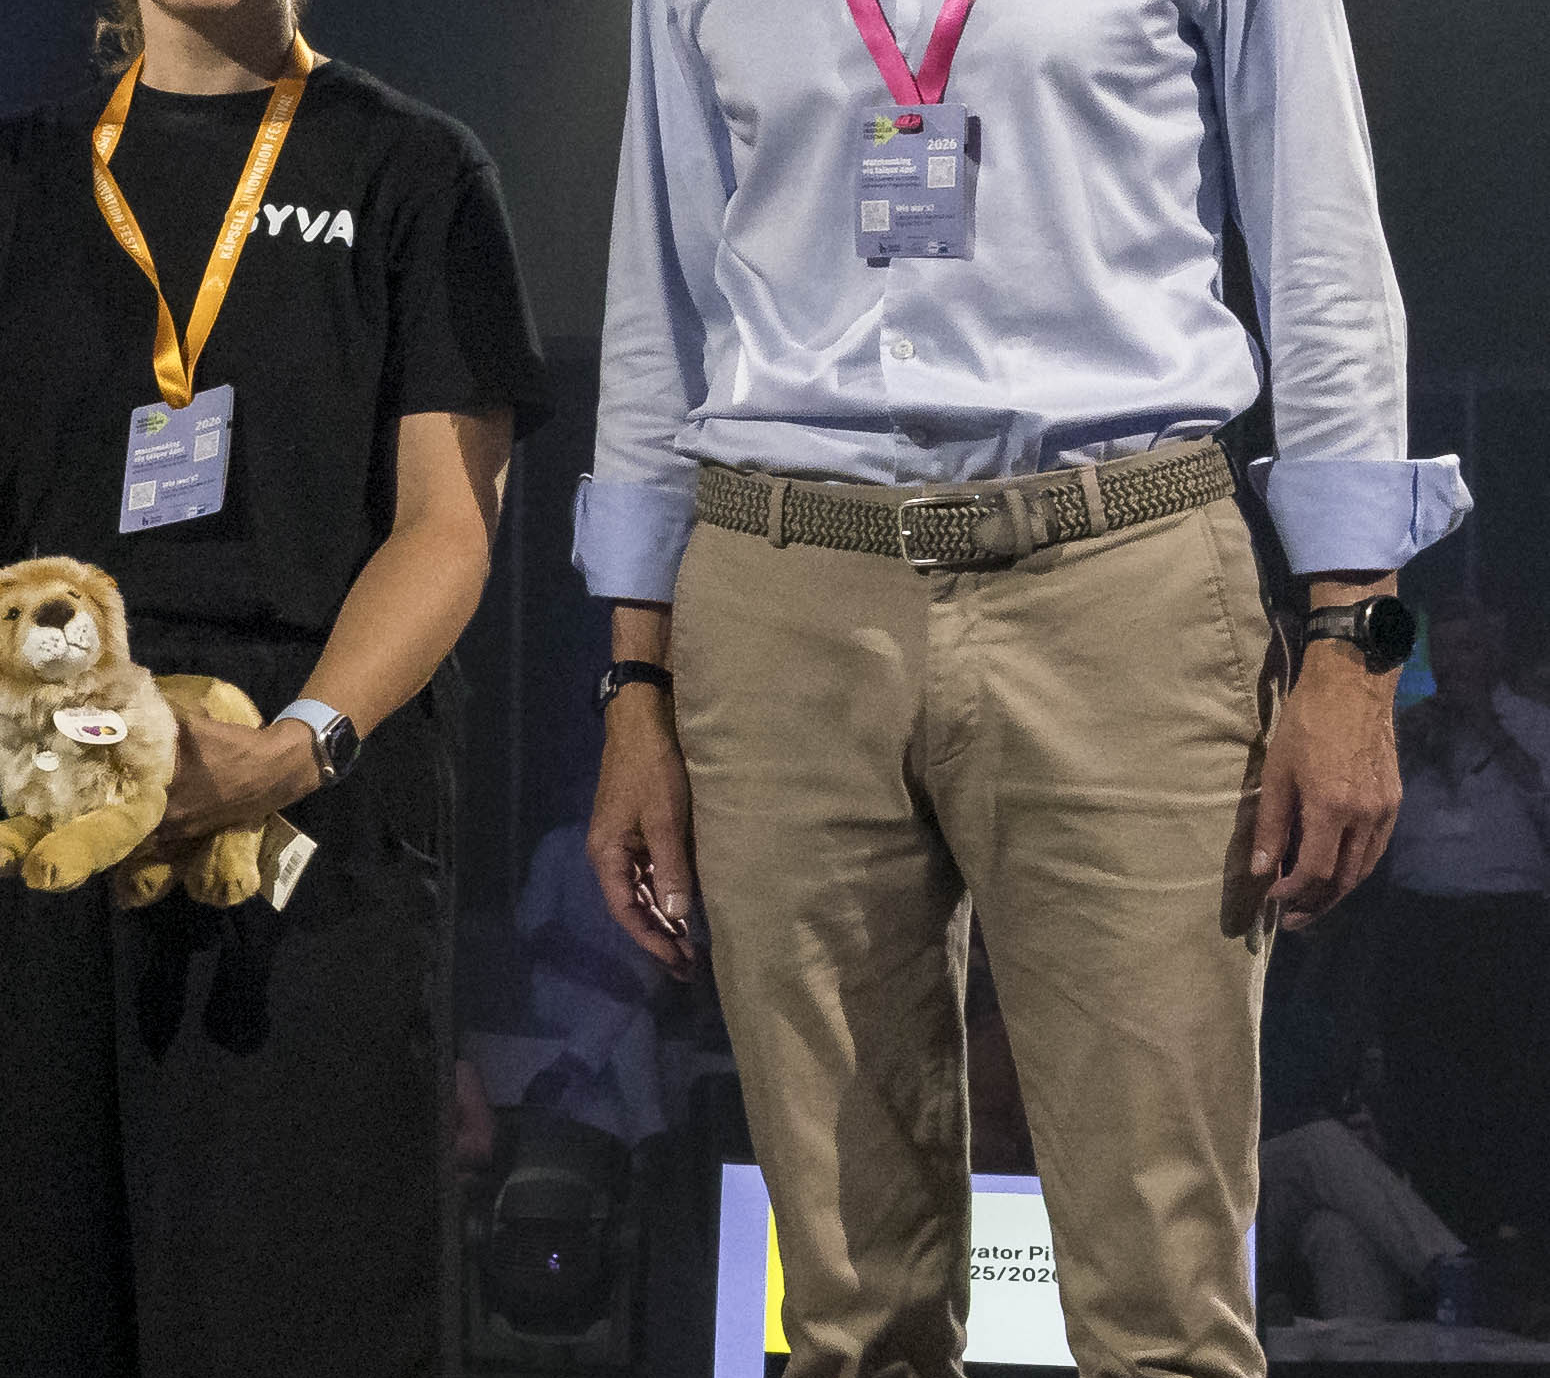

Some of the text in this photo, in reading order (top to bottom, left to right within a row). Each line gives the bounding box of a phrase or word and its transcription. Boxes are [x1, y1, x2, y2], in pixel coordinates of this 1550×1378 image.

[927, 138, 958, 150] 2026
[219, 208, 250, 260] KÄPSELE
[244, 142, 274, 206] INNOVATION
